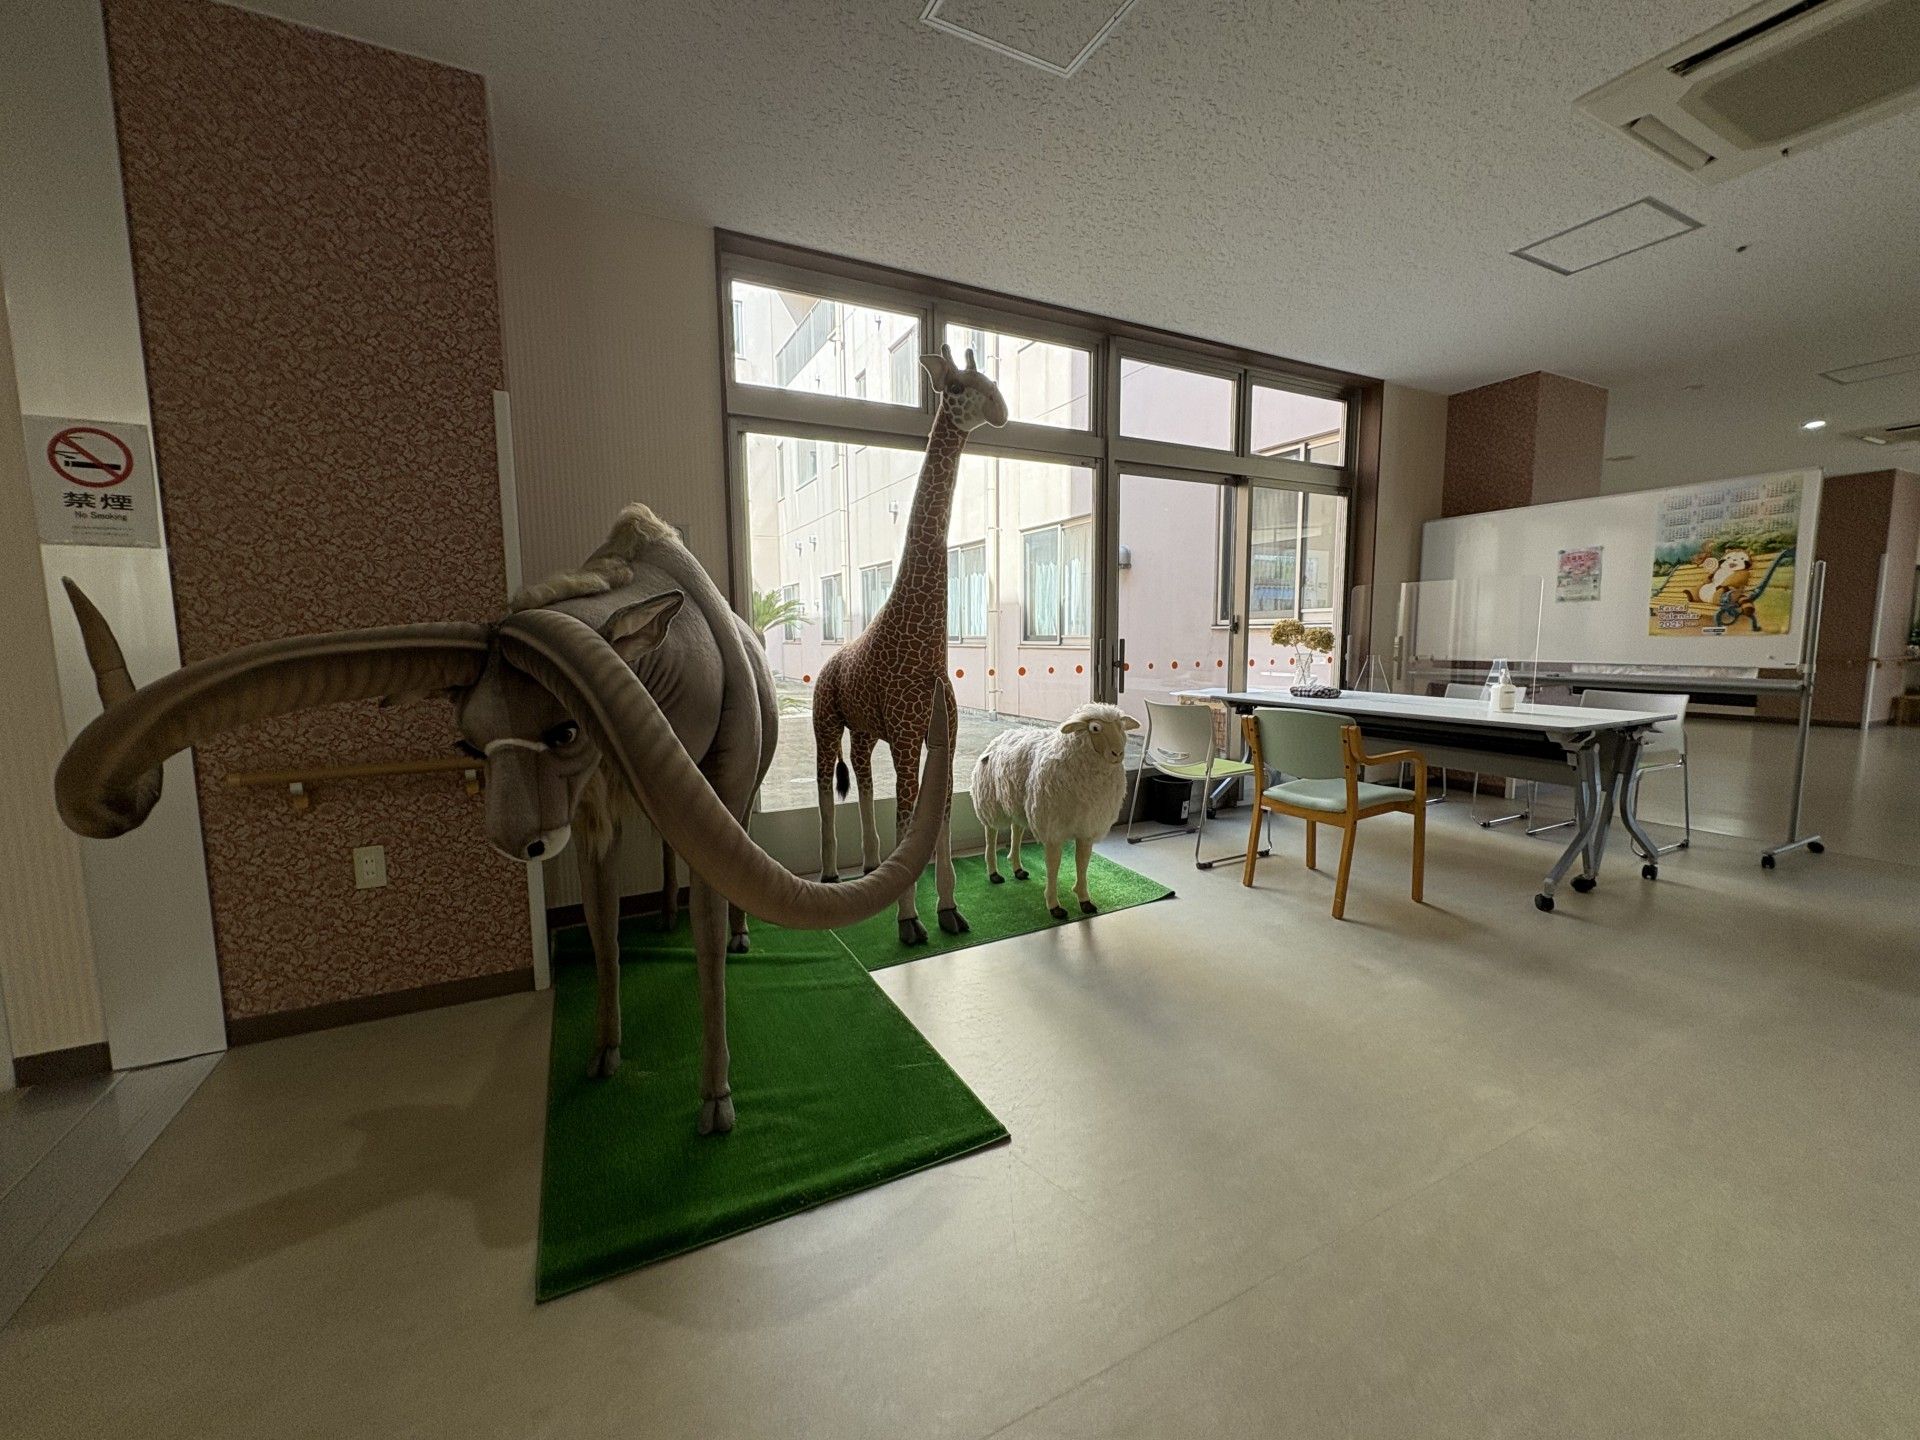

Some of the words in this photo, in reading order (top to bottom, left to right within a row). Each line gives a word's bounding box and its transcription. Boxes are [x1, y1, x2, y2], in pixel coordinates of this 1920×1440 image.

[63, 491, 134, 511] 禁煙
[74, 511, 88, 519] No
[90, 511, 128, 521] Smoking
[1658, 604, 1688, 612] Rascal
[1658, 612, 1701, 621] Calendar
[1658, 621, 1684, 629] 2025
